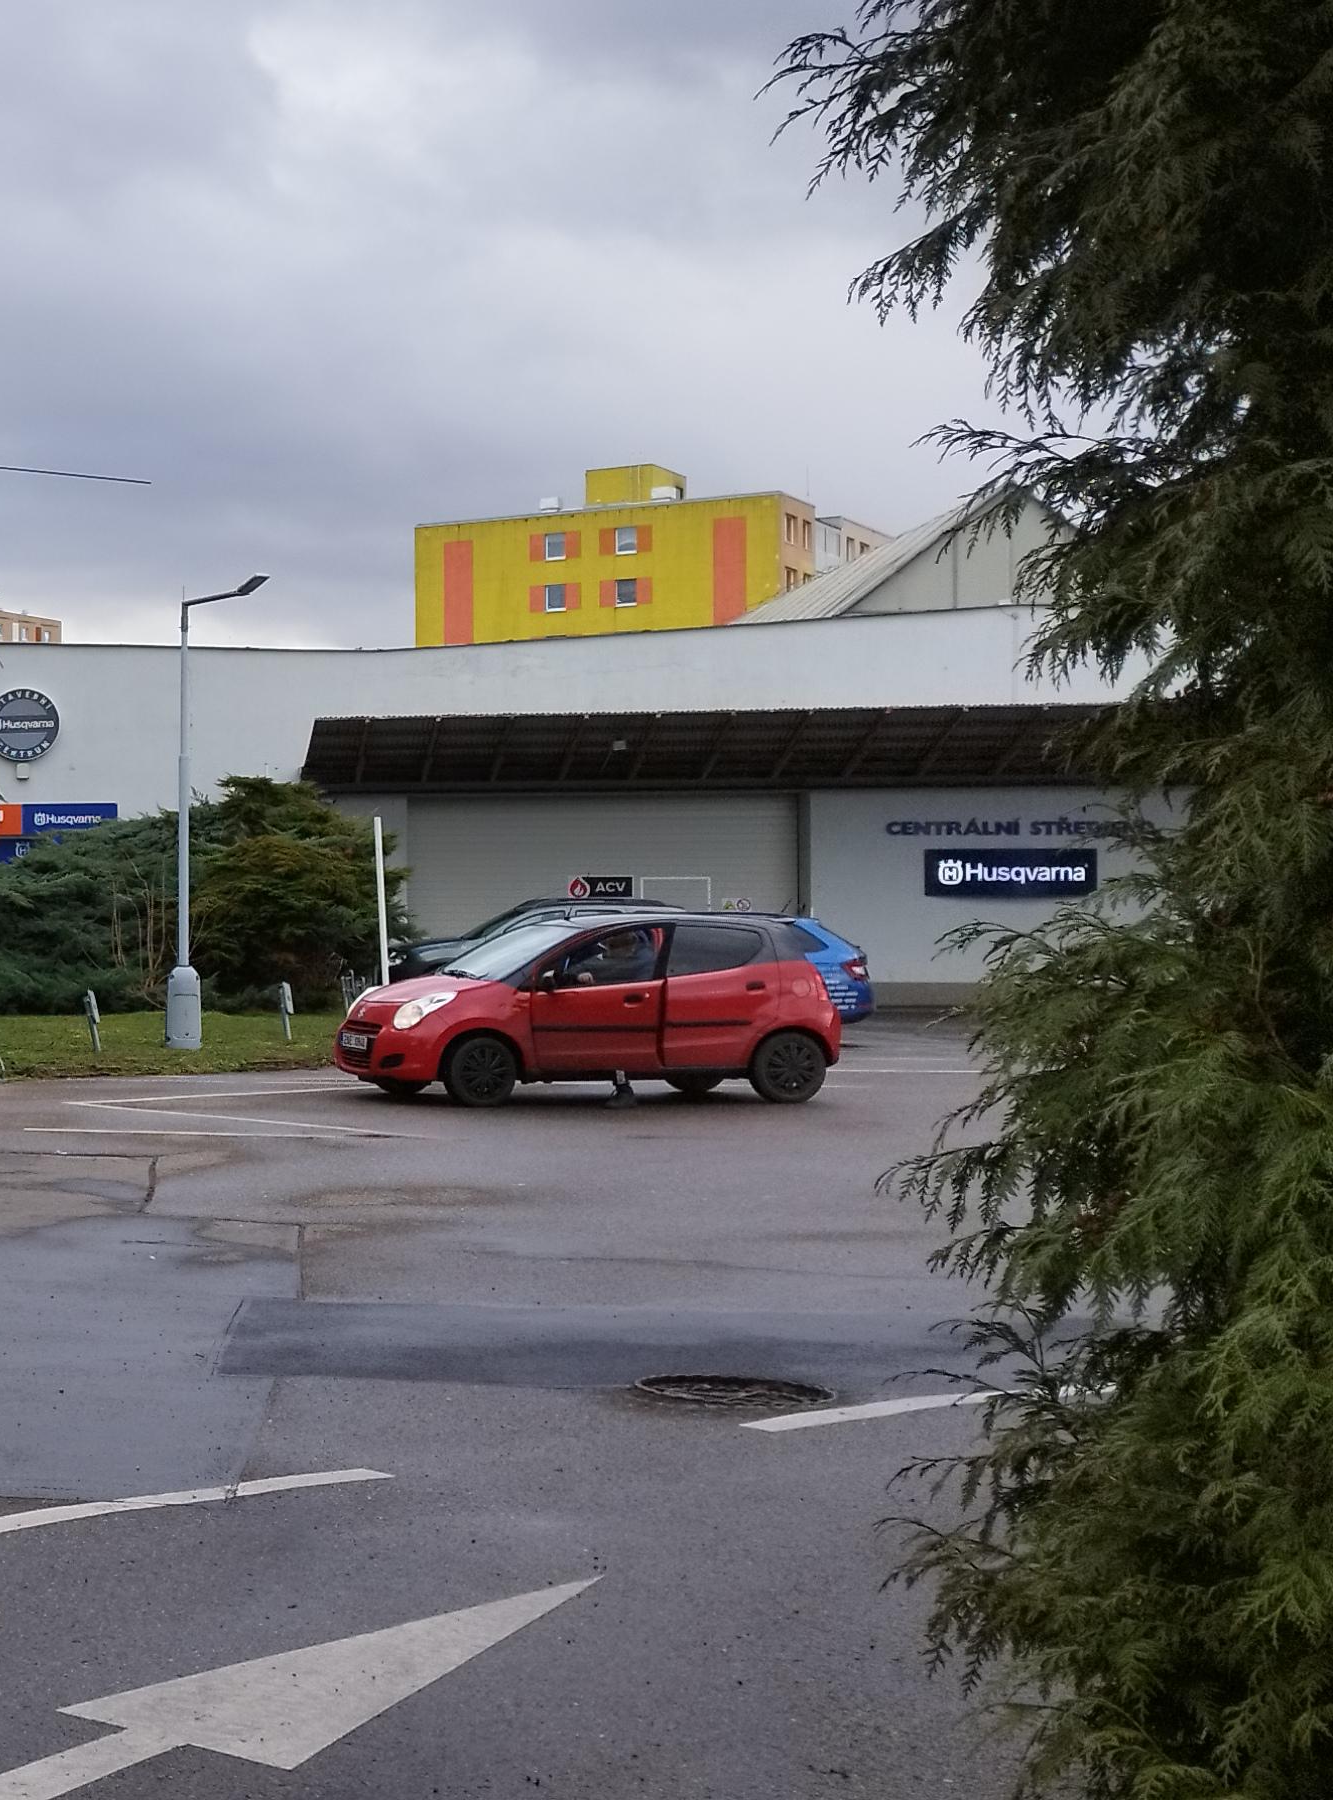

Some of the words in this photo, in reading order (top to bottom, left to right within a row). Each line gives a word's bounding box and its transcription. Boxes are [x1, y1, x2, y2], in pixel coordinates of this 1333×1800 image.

[3, 719, 55, 730] Husqvarna
[885, 817, 1021, 836] CENTRÁLNÍ
[965, 861, 1086, 885] Husqvarna
[595, 881, 627, 893] ACV
